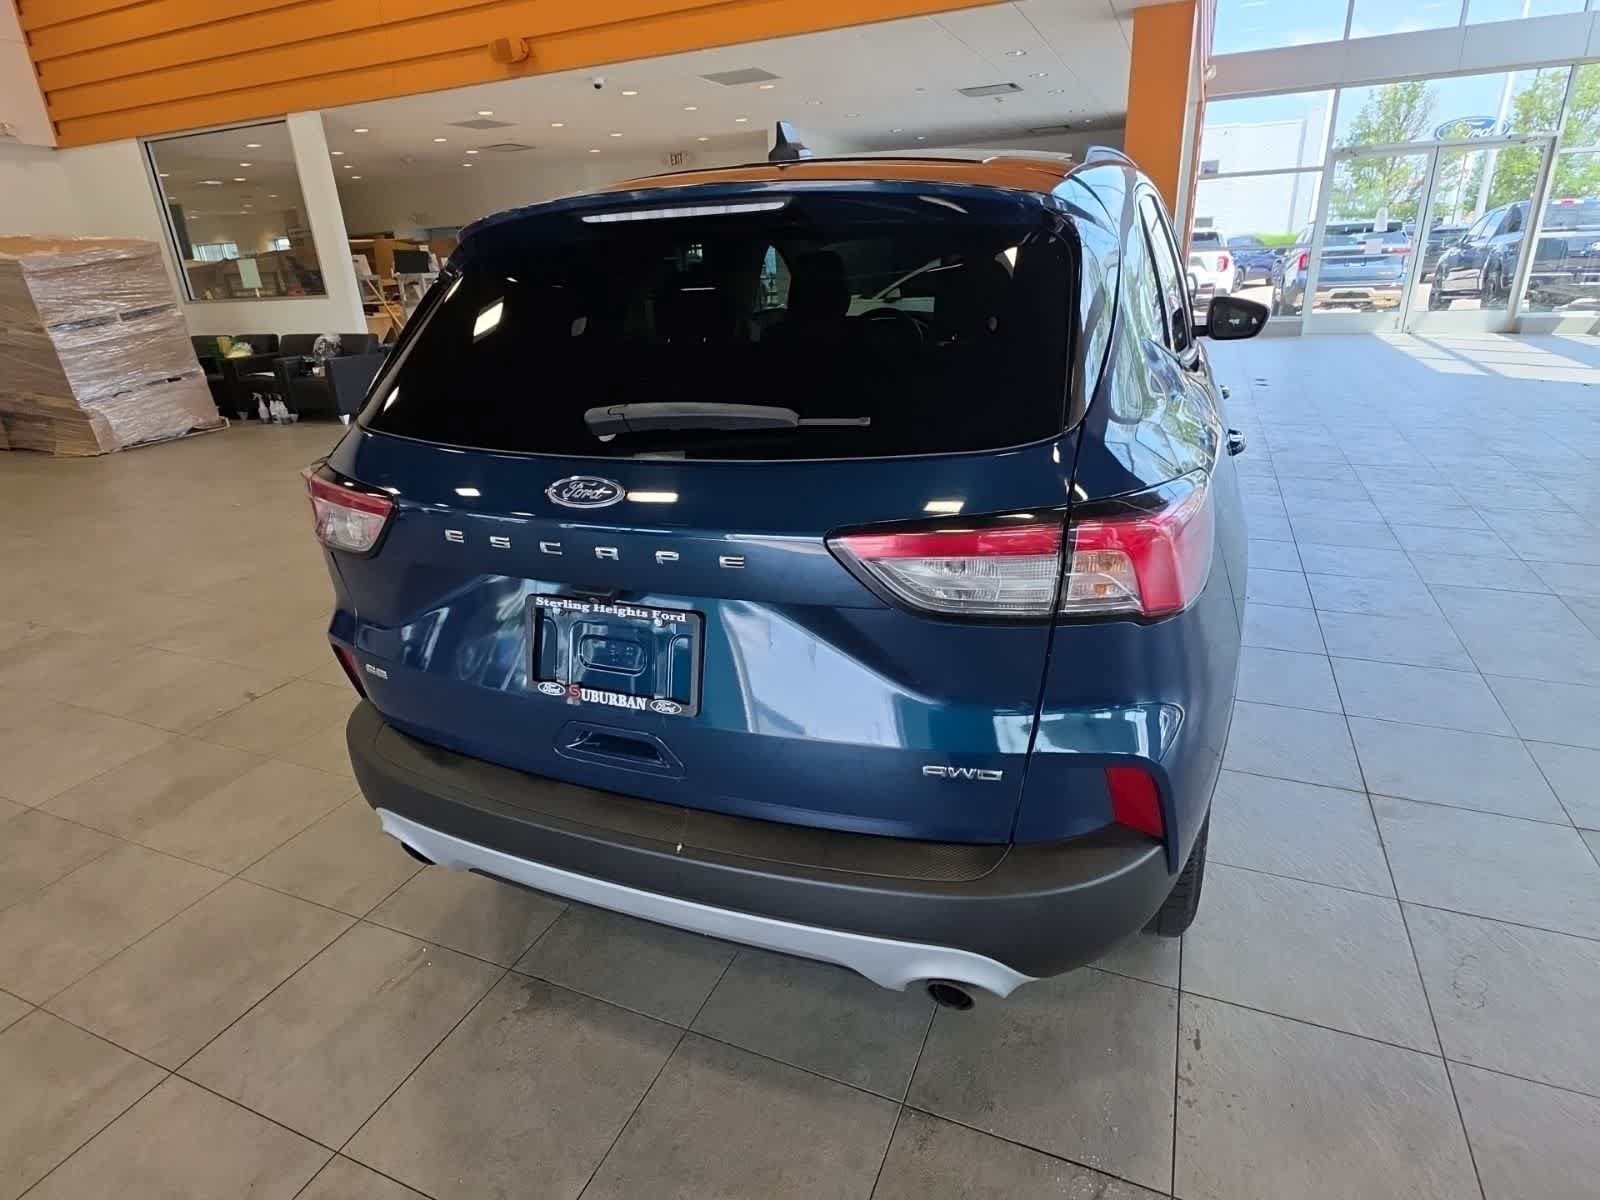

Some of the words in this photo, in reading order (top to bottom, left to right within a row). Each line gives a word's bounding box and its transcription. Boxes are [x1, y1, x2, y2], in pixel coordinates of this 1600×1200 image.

[560, 479, 611, 501] Ford
[445, 528, 745, 569] ESCAPE
[536, 596, 590, 613] Sterling
[593, 603, 648, 619] Heights
[652, 610, 686, 623] Ford
[540, 682, 563, 695] Ford
[568, 684, 647, 711] SUBURBAN
[653, 700, 679, 713] Ford
[922, 765, 1003, 781] AWD
